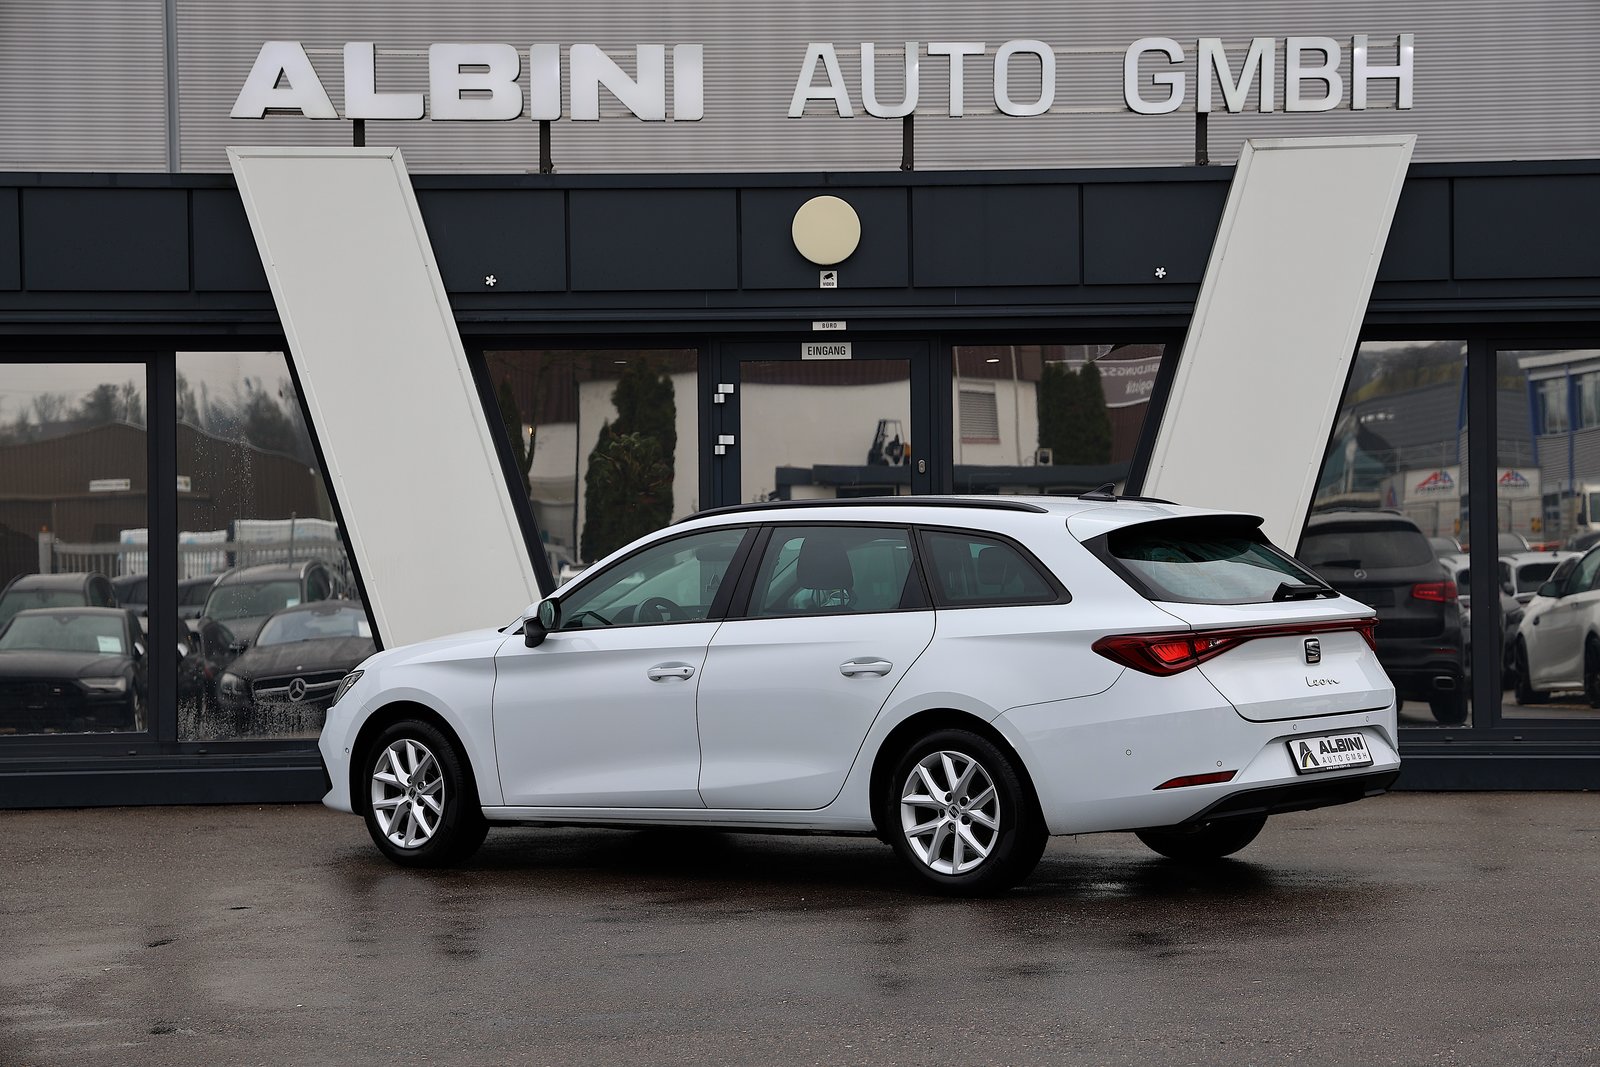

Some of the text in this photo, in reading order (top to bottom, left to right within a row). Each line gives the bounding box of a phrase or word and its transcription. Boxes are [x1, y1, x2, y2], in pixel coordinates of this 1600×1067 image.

[230, 33, 1415, 121] ALBINI AUTO GMBH
[807, 346, 846, 356] EINGANG
[1319, 736, 1364, 754] ALBINI
[1322, 752, 1368, 764] AUTO GMBH
